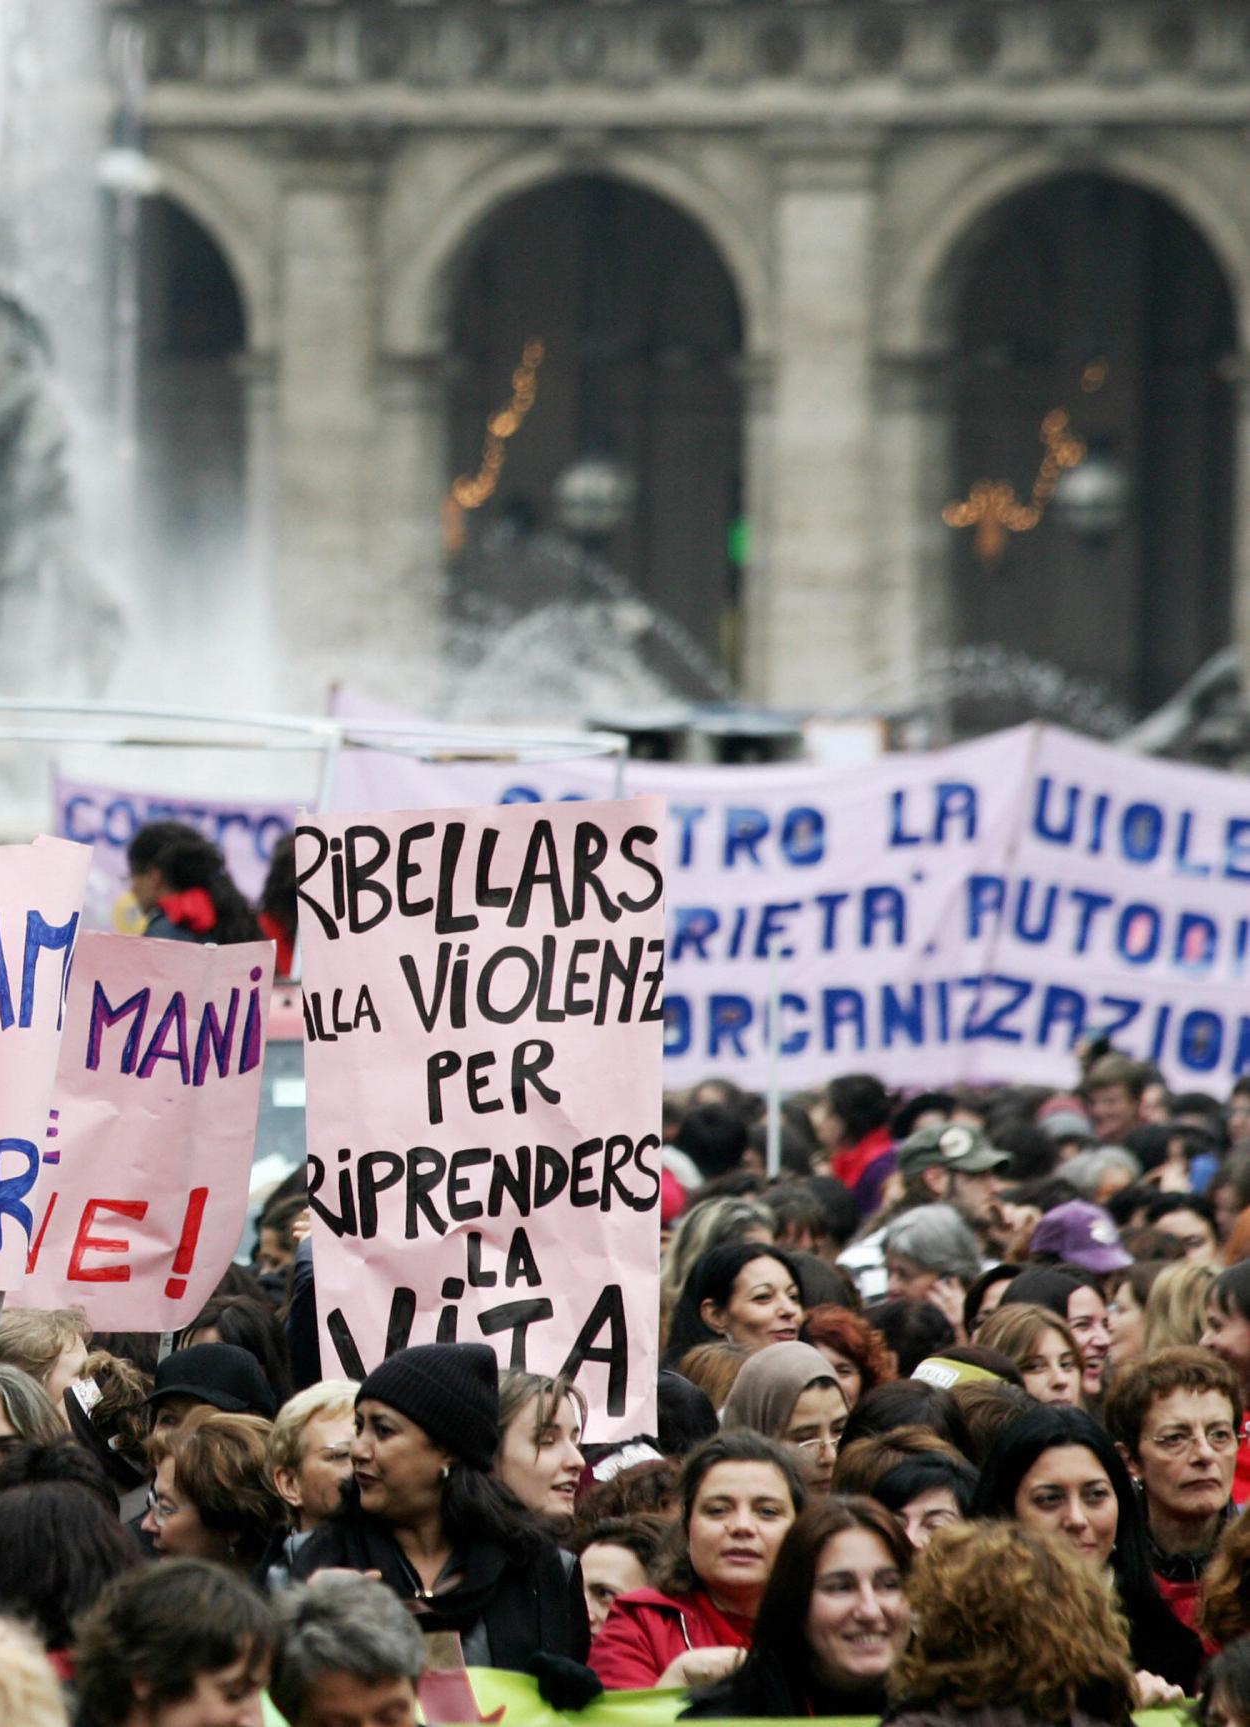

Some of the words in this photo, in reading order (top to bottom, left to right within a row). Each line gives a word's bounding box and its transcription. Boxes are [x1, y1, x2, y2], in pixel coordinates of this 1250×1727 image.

[889, 781, 978, 847] LA
[427, 1039, 561, 1125] PER
[467, 1226, 542, 1288] LA
